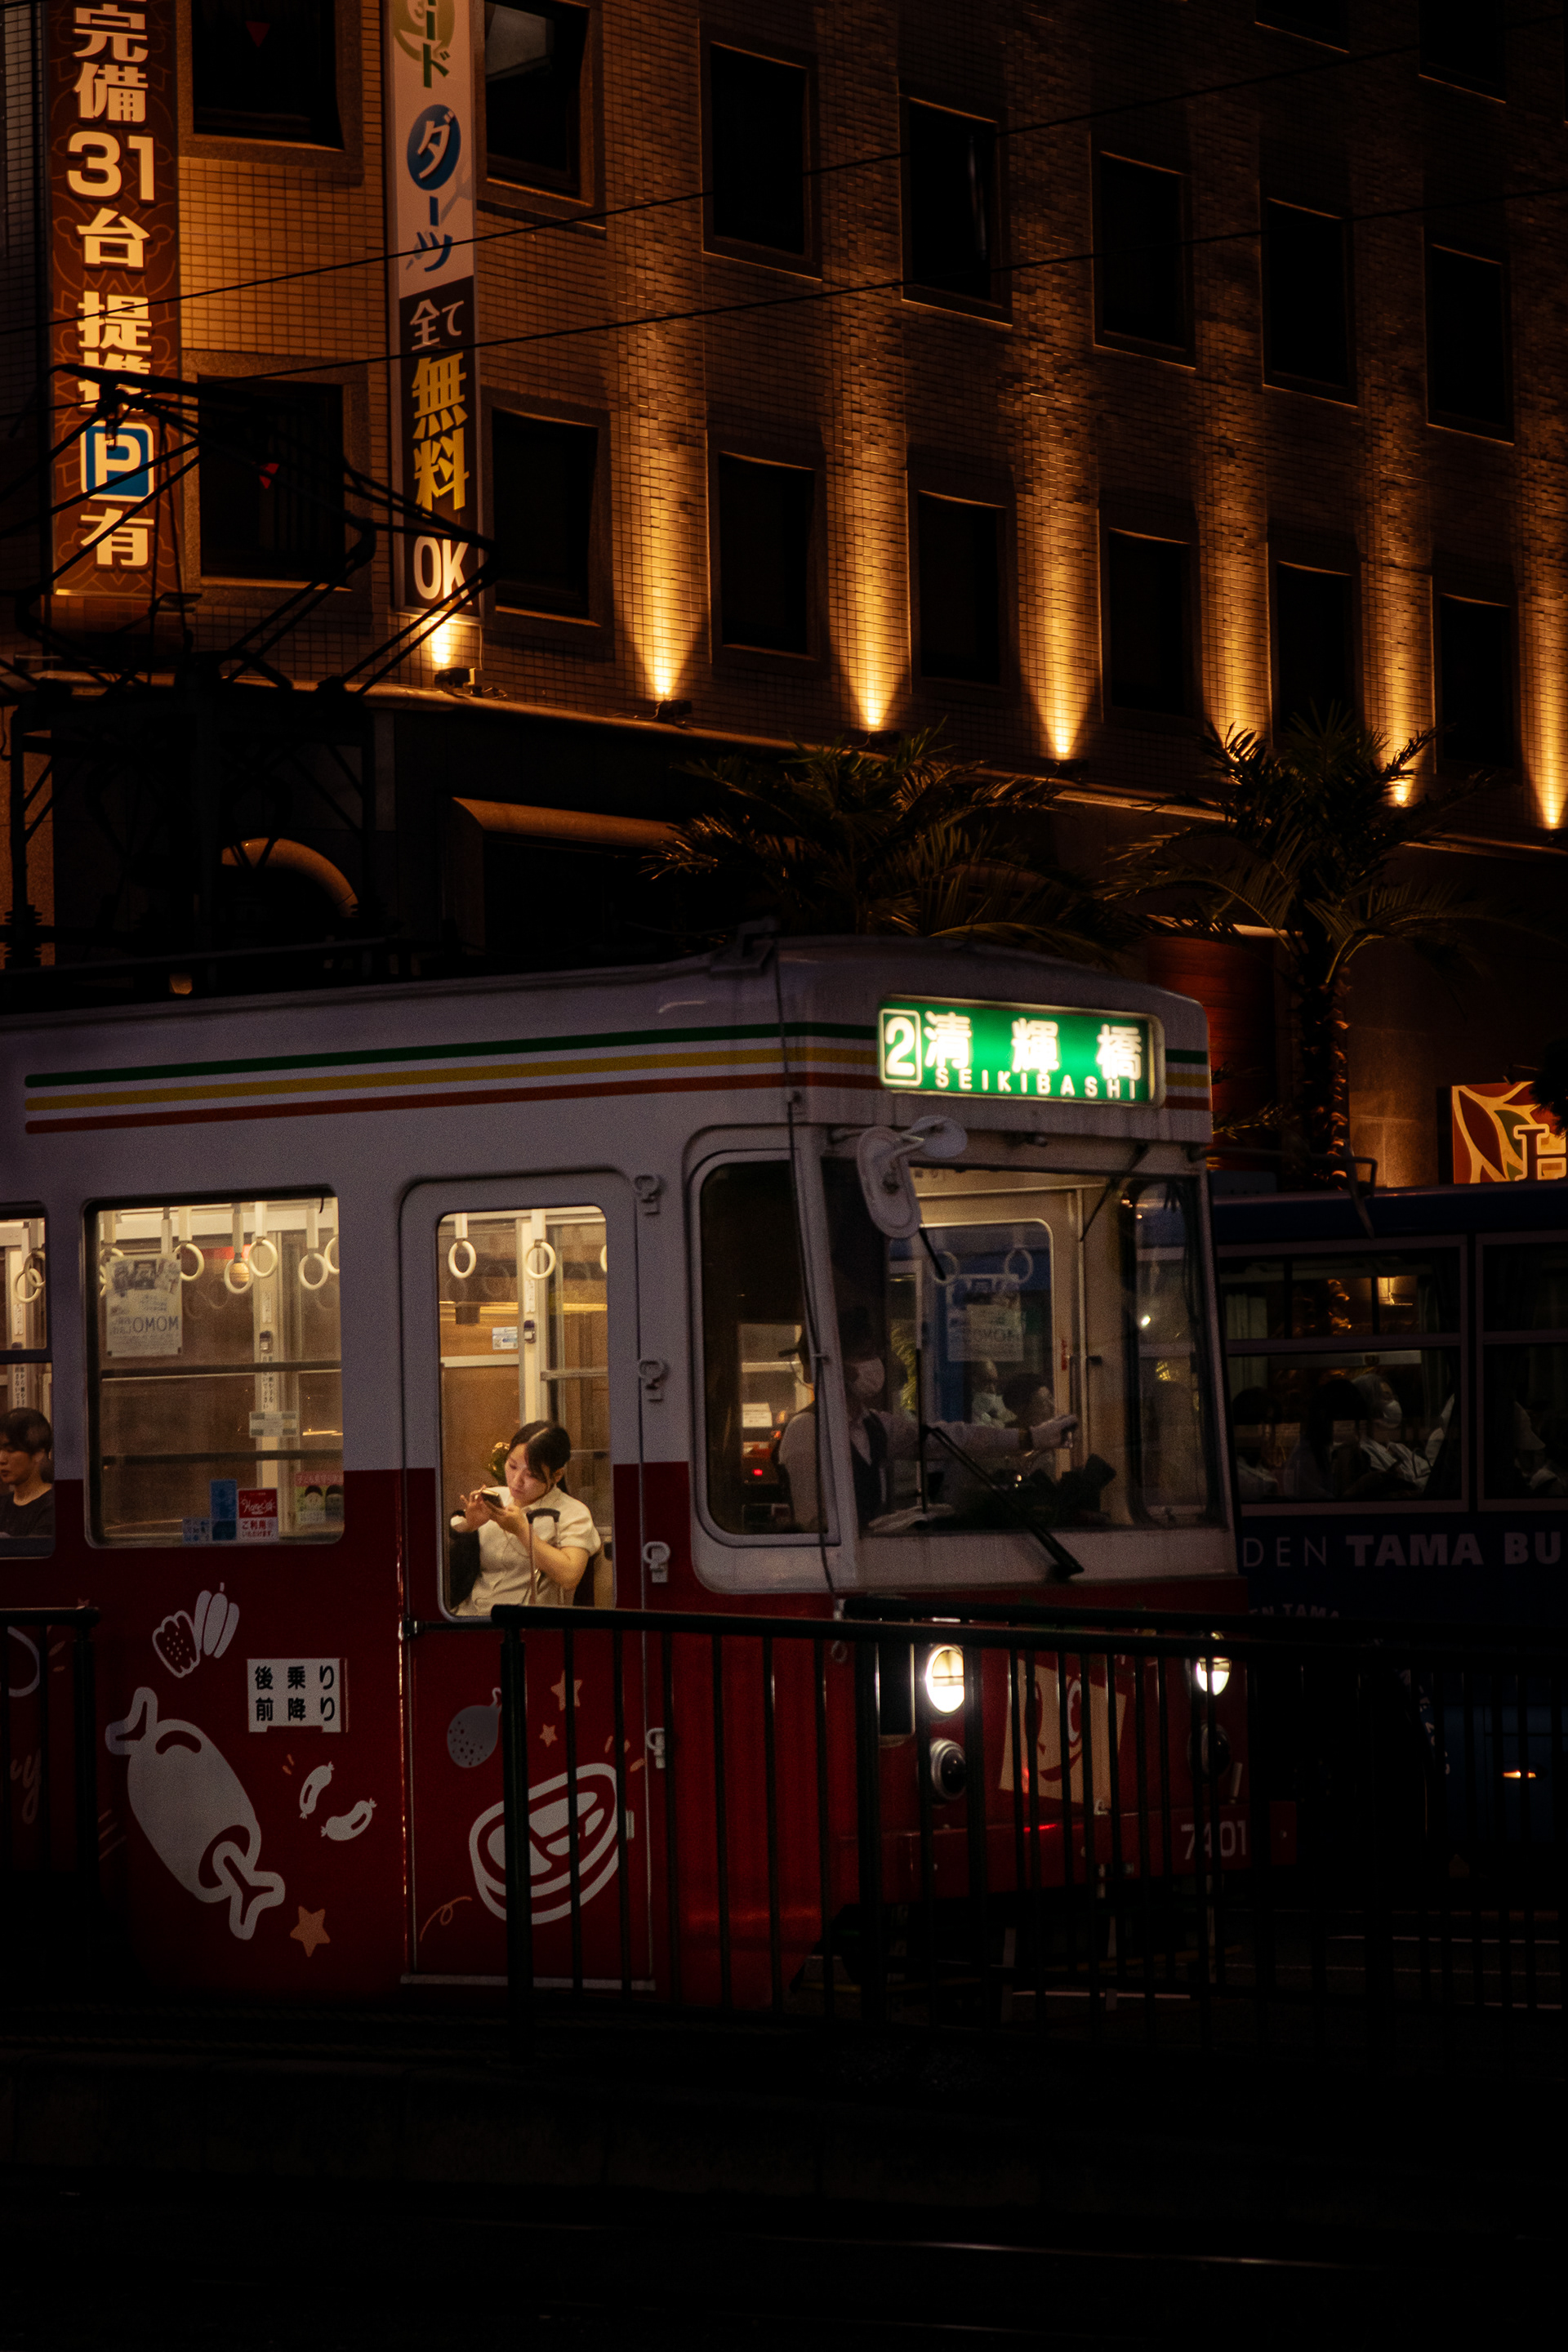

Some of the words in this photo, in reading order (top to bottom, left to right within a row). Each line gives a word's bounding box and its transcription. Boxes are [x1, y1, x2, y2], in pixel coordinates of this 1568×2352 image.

[416, 109, 457, 273] ダーツ
[884, 1016, 915, 1076] 2
[934, 1065, 1137, 1100] SEIKIBASHI
[1345, 1532, 1485, 1568] TAMA
[1503, 1530, 1562, 1566] BU
[255, 1665, 335, 1690] 後乗り
[256, 1696, 336, 1722] 前降り
